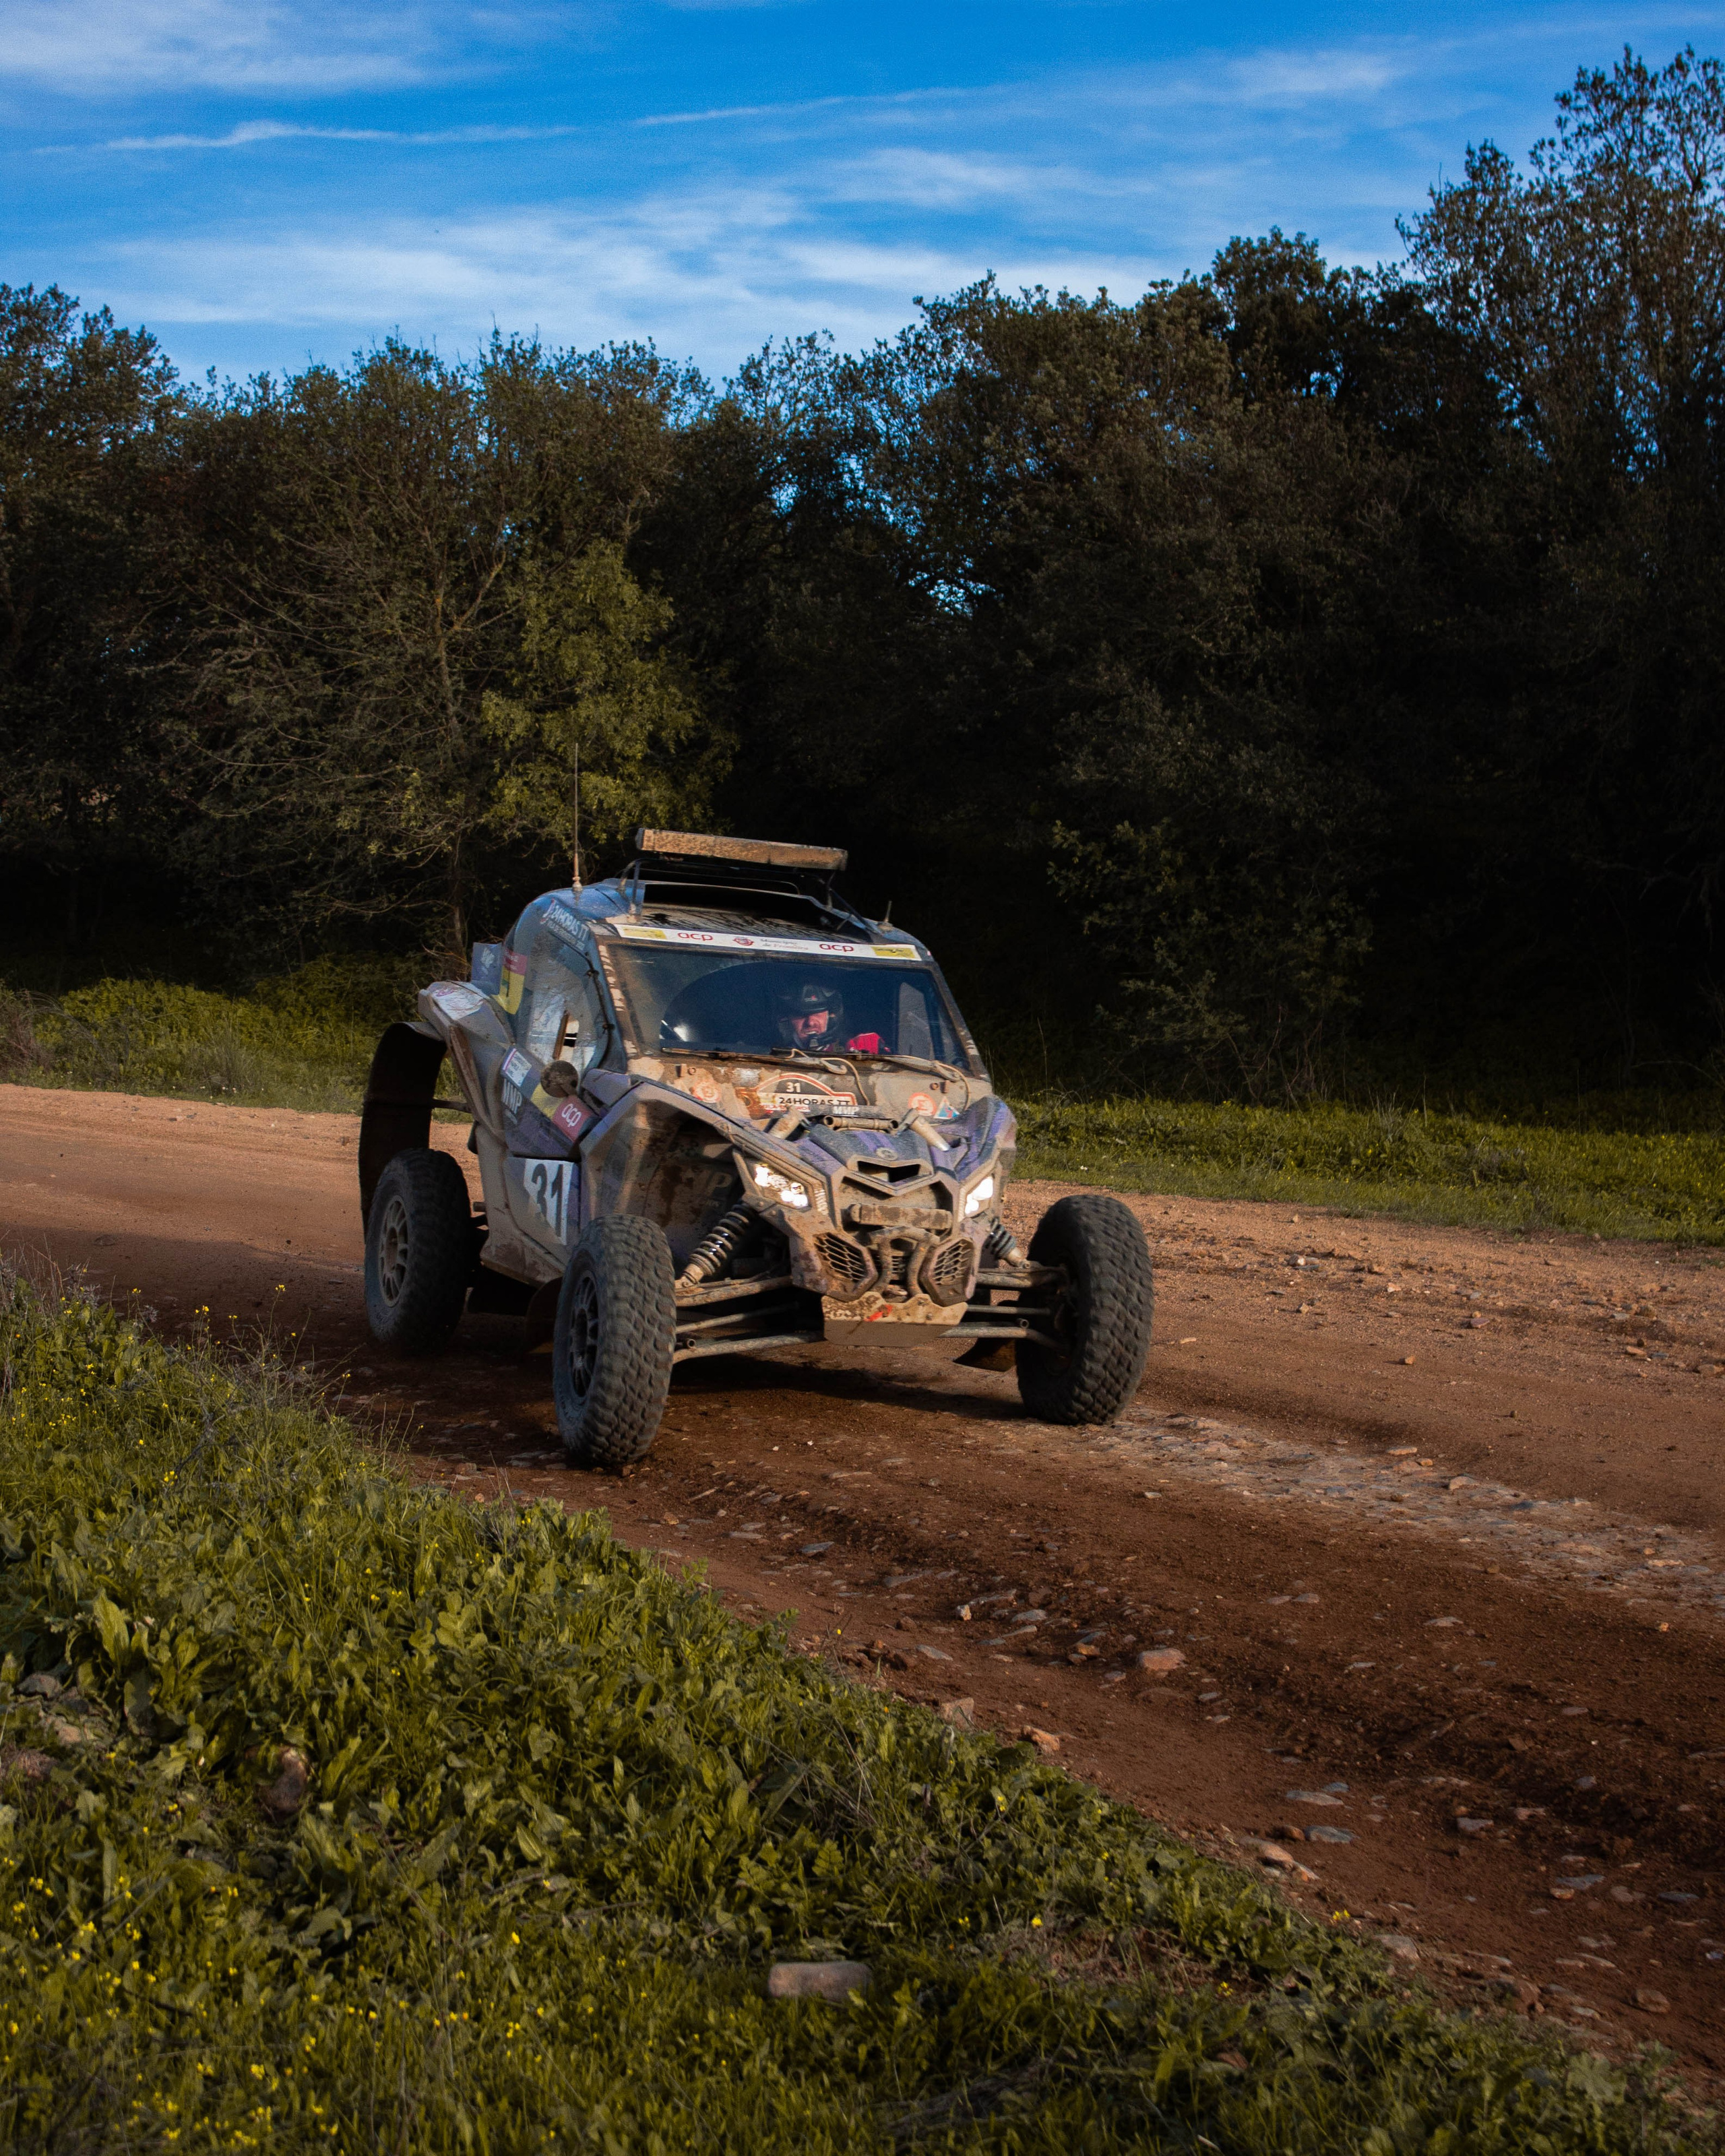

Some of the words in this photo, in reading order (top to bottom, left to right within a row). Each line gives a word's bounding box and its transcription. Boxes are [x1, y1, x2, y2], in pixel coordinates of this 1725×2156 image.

[677, 932, 714, 941] acp
[819, 943, 854, 952] acp
[786, 1082, 801, 1092] 31
[561, 1103, 582, 1127] acp
[532, 1163, 563, 1237] 31
